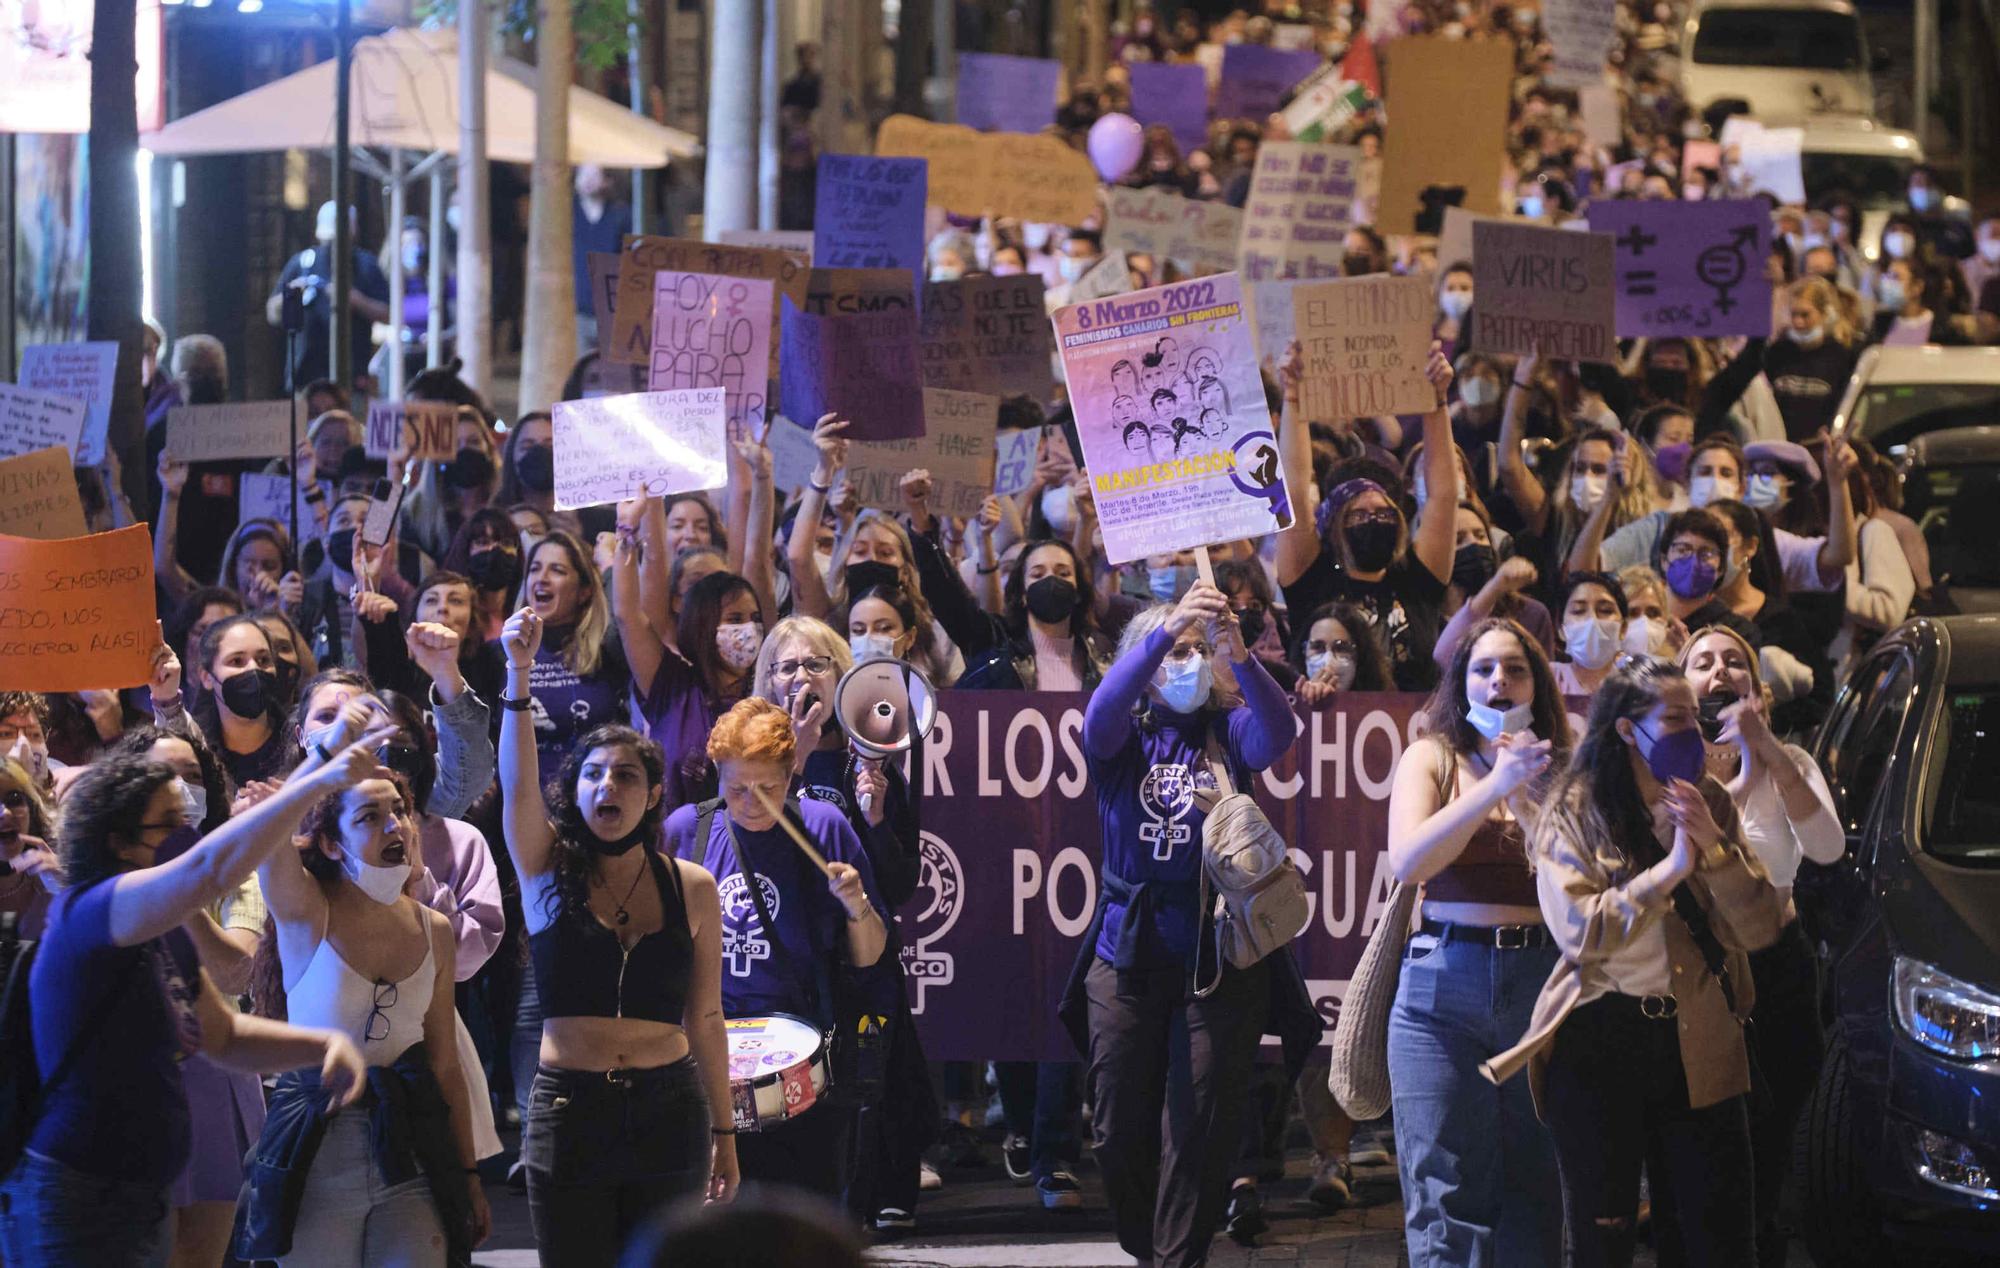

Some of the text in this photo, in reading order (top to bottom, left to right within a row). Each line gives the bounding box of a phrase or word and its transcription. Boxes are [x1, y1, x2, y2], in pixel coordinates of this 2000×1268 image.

[1501, 254, 1588, 293] VIRUS
[657, 275, 722, 311] HOY
[1077, 282, 1216, 329] 8 Marzo 2022
[1308, 301, 1336, 328] EL
[655, 317, 753, 356] LUCHO
[1065, 327, 1121, 347] FEMINISMOS
[1122, 318, 1168, 337] CANARIOS
[1169, 314, 1185, 327] SIN
[1187, 304, 1239, 322] FRONTERAS
[1309, 337, 1335, 354] TE
[652, 350, 745, 391] PARA
[697, 391, 720, 404] DEL
[934, 392, 986, 416] JUST
[371, 409, 392, 450] NO
[423, 414, 453, 453] NO
[936, 432, 982, 456] HAVE
[628, 471, 647, 481] ES
[1101, 499, 1129, 510] Martes
[1140, 495, 1150, 503] de
[1121, 505, 1131, 514] de
[41, 563, 147, 592] SEMBRARON
[0, 607, 102, 630] EDO, NOS
[0, 641, 79, 656] ECIERON
[978, 707, 1087, 799] LOS
[1150, 828, 1182, 839] TACO
[1013, 846, 1096, 938] PO
[723, 943, 761, 954] TACO
[903, 946, 916, 957] DE
